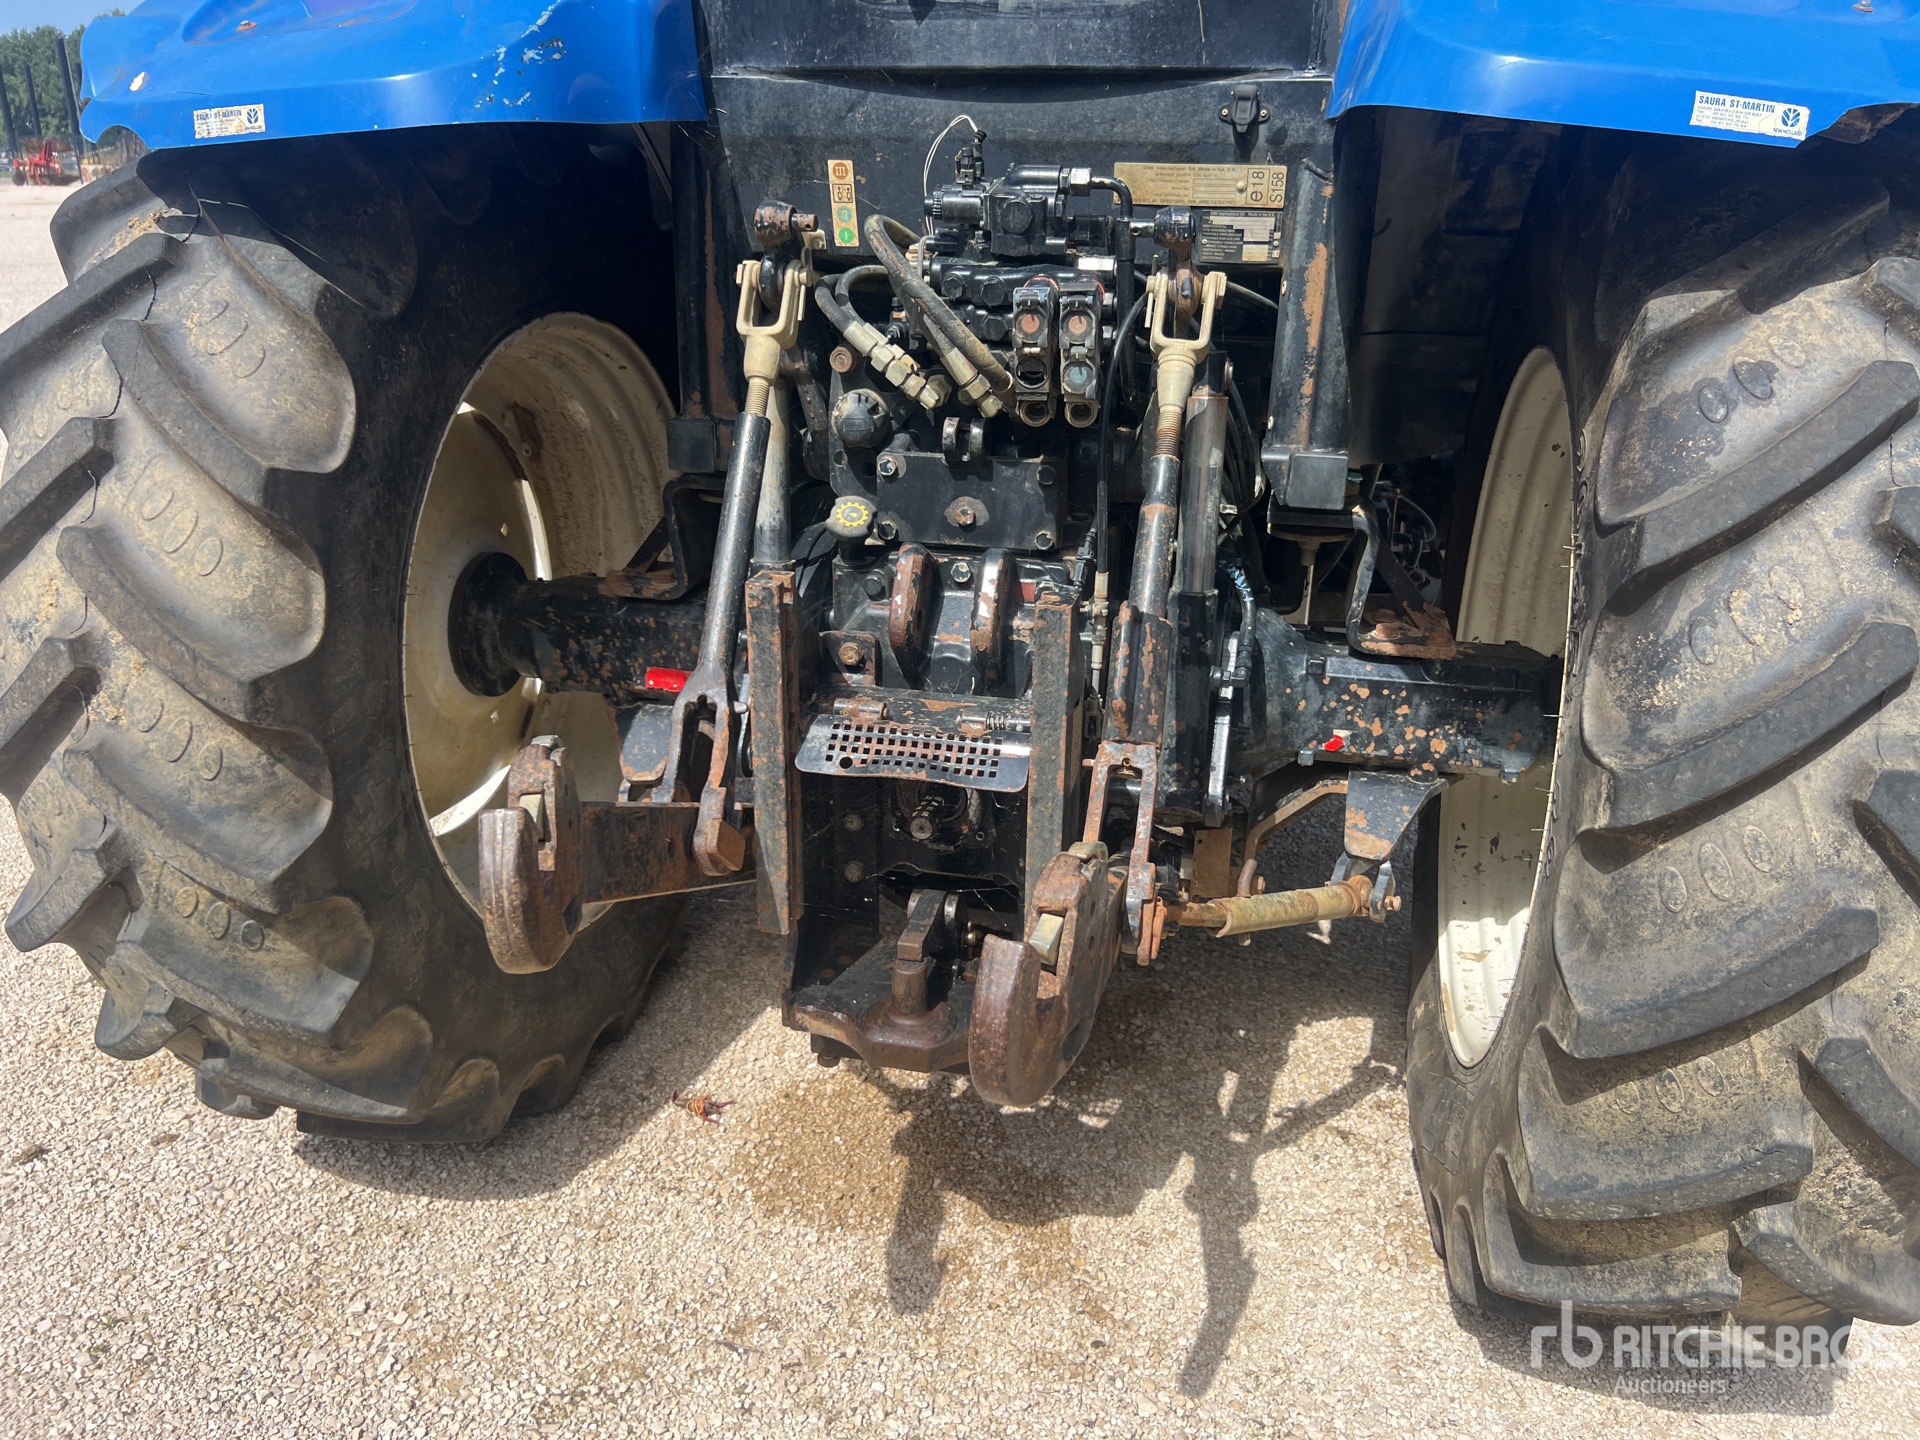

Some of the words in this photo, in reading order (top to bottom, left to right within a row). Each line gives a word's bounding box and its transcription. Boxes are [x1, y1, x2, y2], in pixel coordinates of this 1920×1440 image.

[1698, 95, 1726, 107] SAURA
[1729, 98, 1776, 113] ST-MARTIN
[1250, 171, 1265, 202] e18
[1269, 172, 1284, 203] S158
